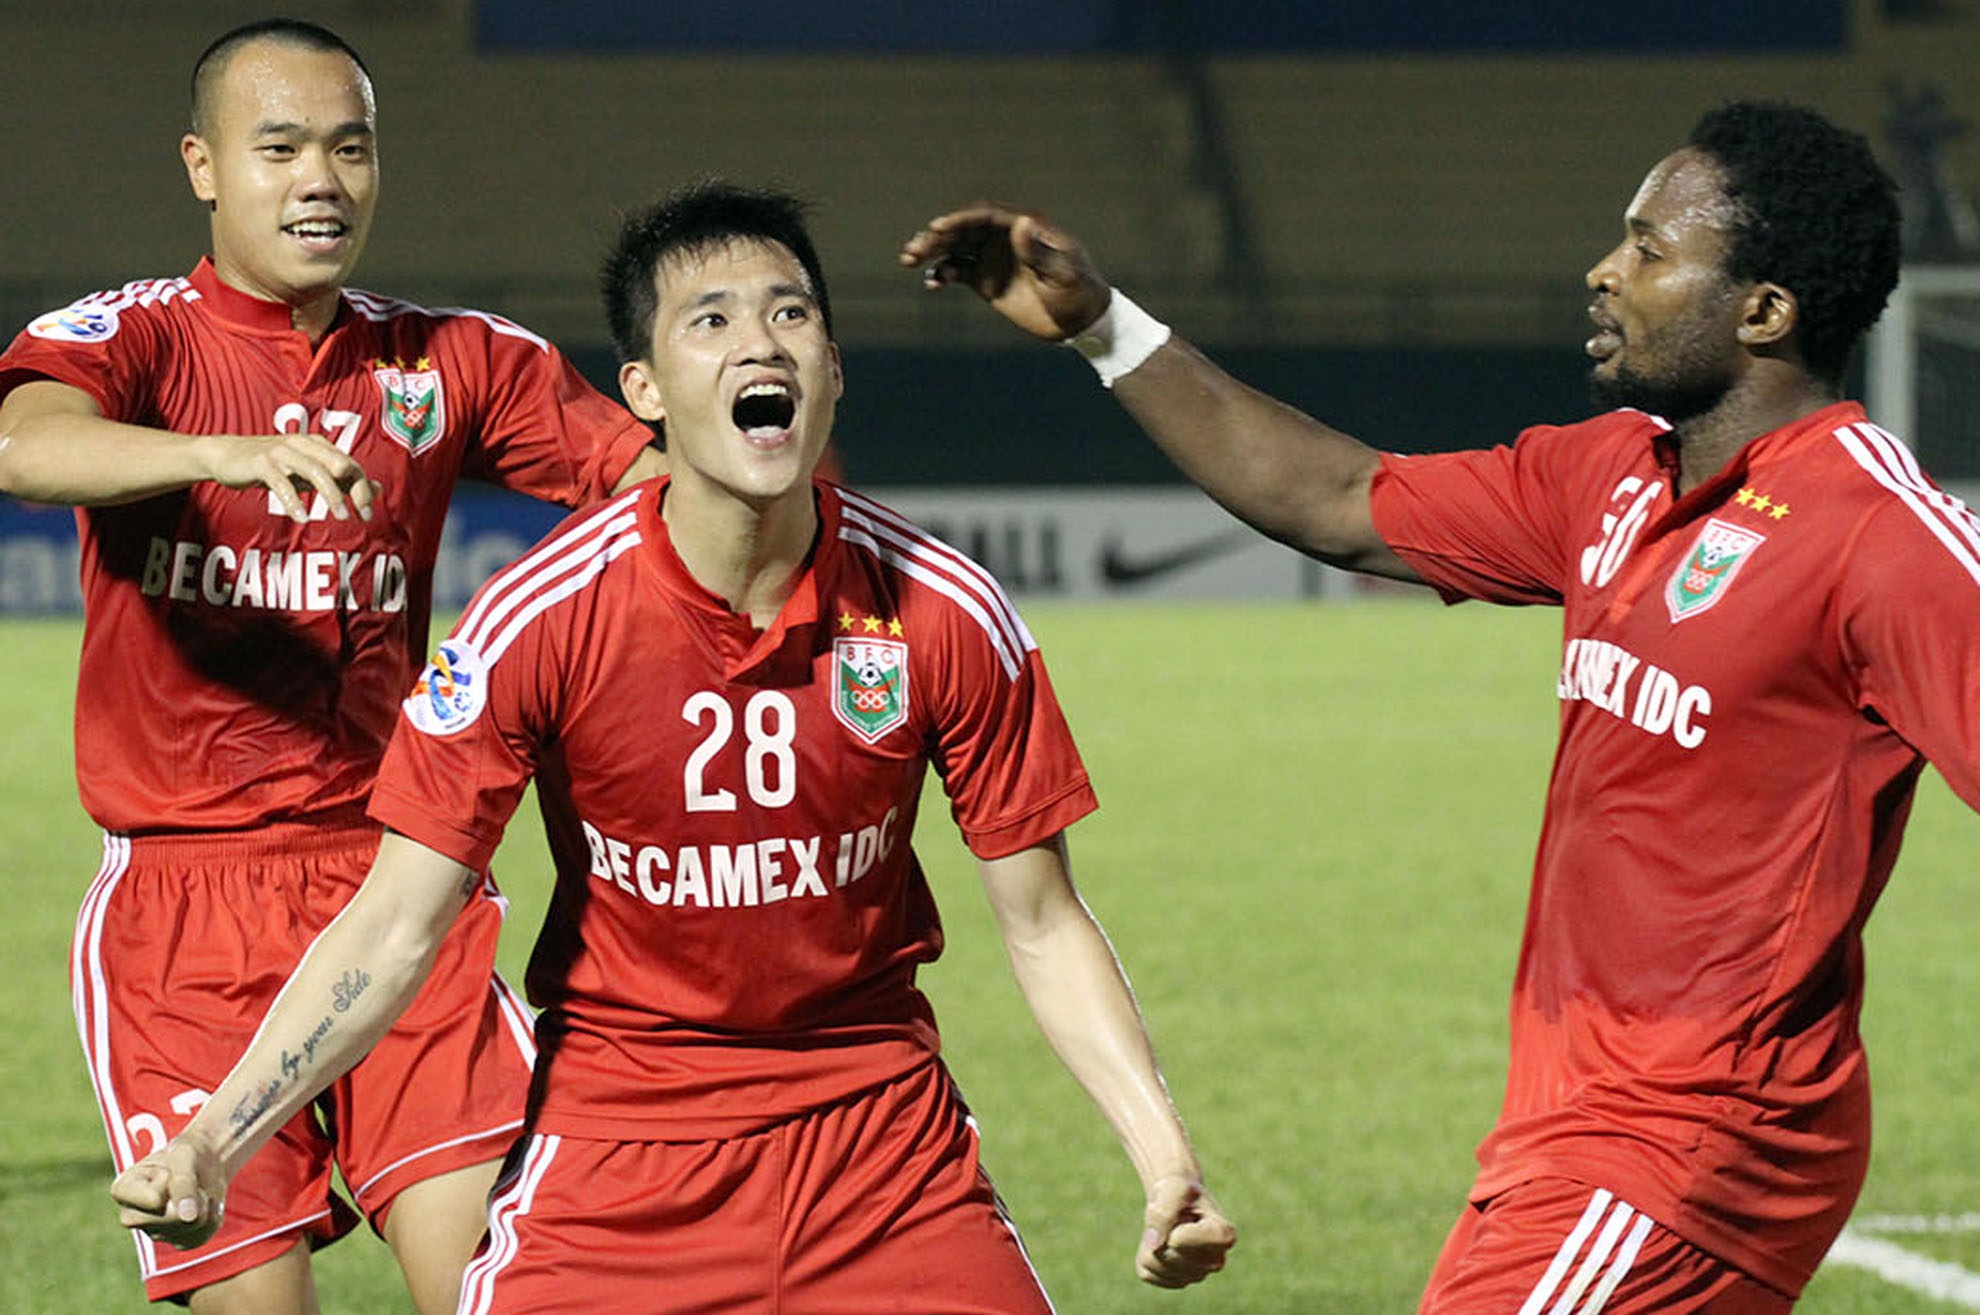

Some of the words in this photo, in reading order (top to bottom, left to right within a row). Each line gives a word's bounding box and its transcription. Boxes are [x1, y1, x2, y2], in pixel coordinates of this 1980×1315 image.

[141, 537, 362, 611] BECAMEX
[846, 646, 896, 665] BFC
[1631, 664, 1712, 749] IDC
[681, 690, 796, 812] 28
[582, 820, 829, 908] BECAMEX
[836, 806, 899, 888] IDC
